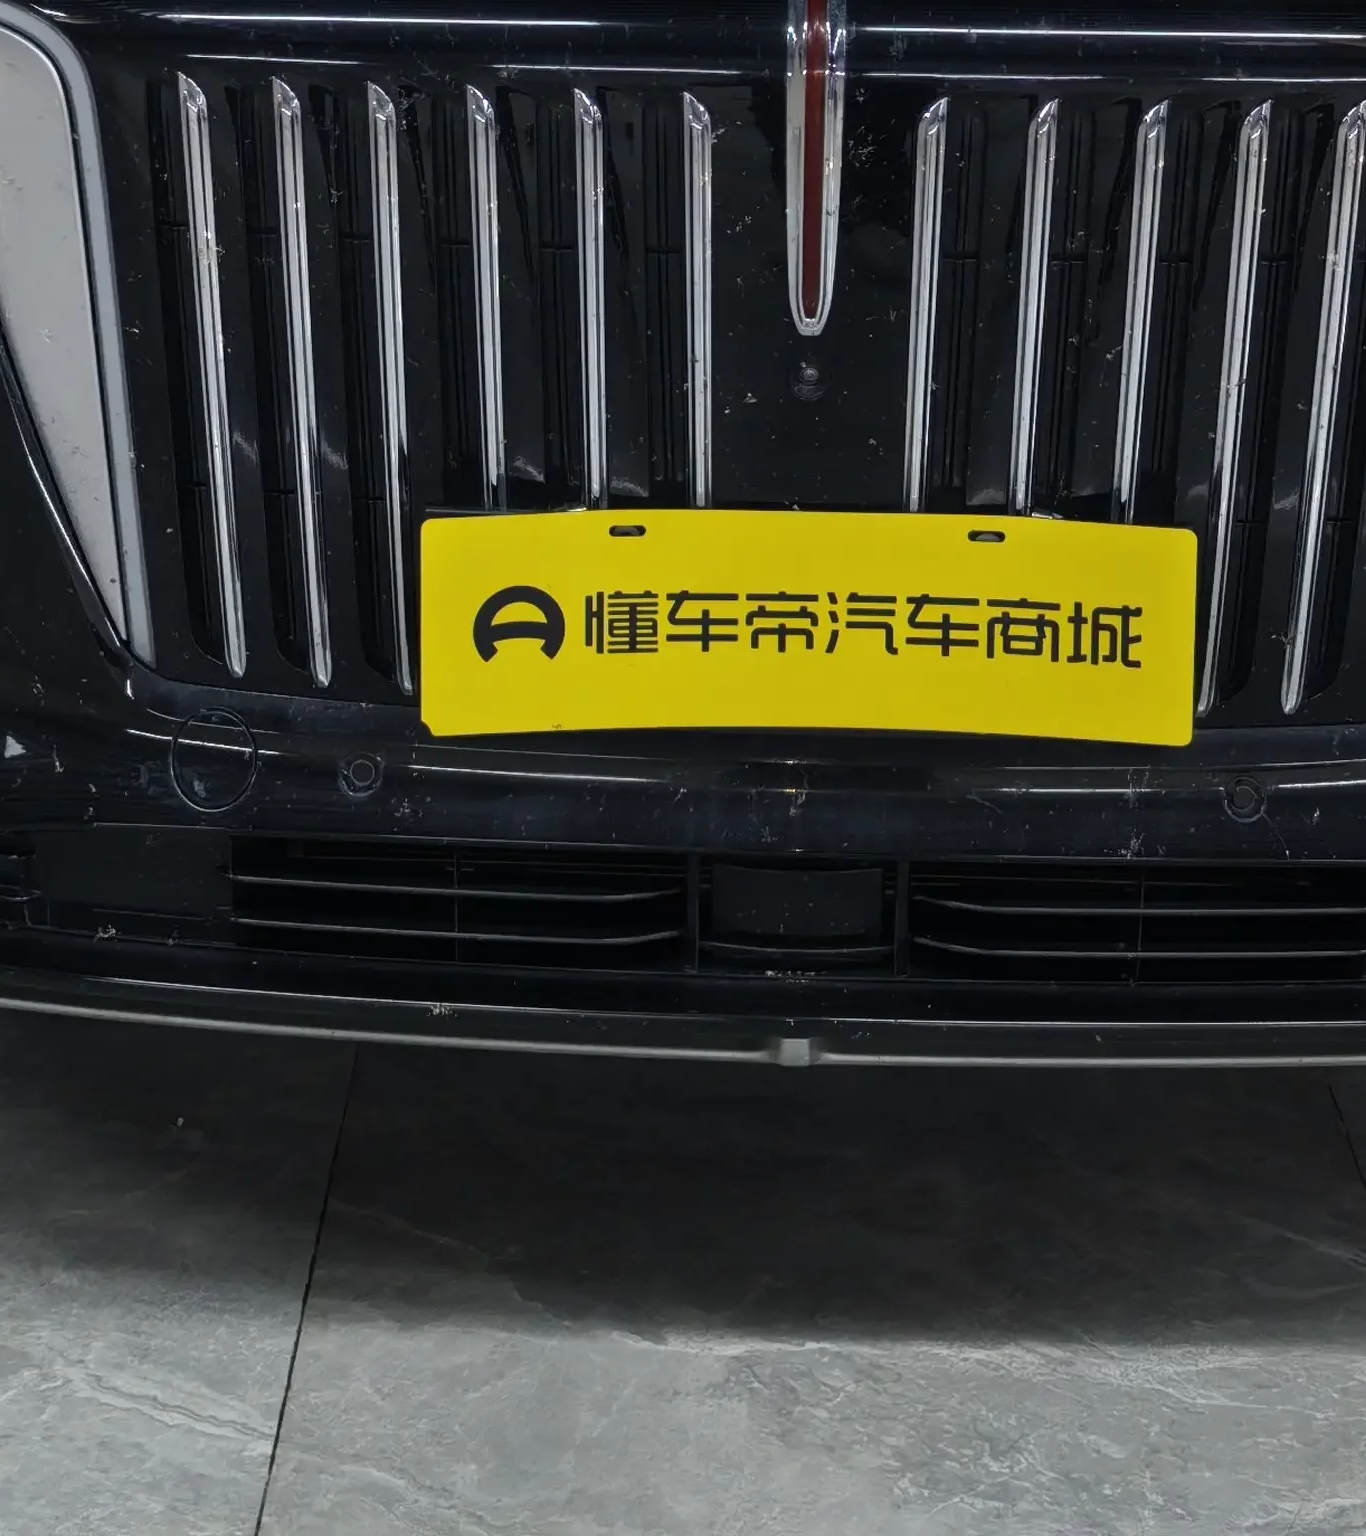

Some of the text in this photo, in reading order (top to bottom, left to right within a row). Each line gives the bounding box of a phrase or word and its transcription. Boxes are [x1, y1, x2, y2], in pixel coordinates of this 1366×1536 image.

[585, 590, 1143, 669] 懂车帝汽车商城
